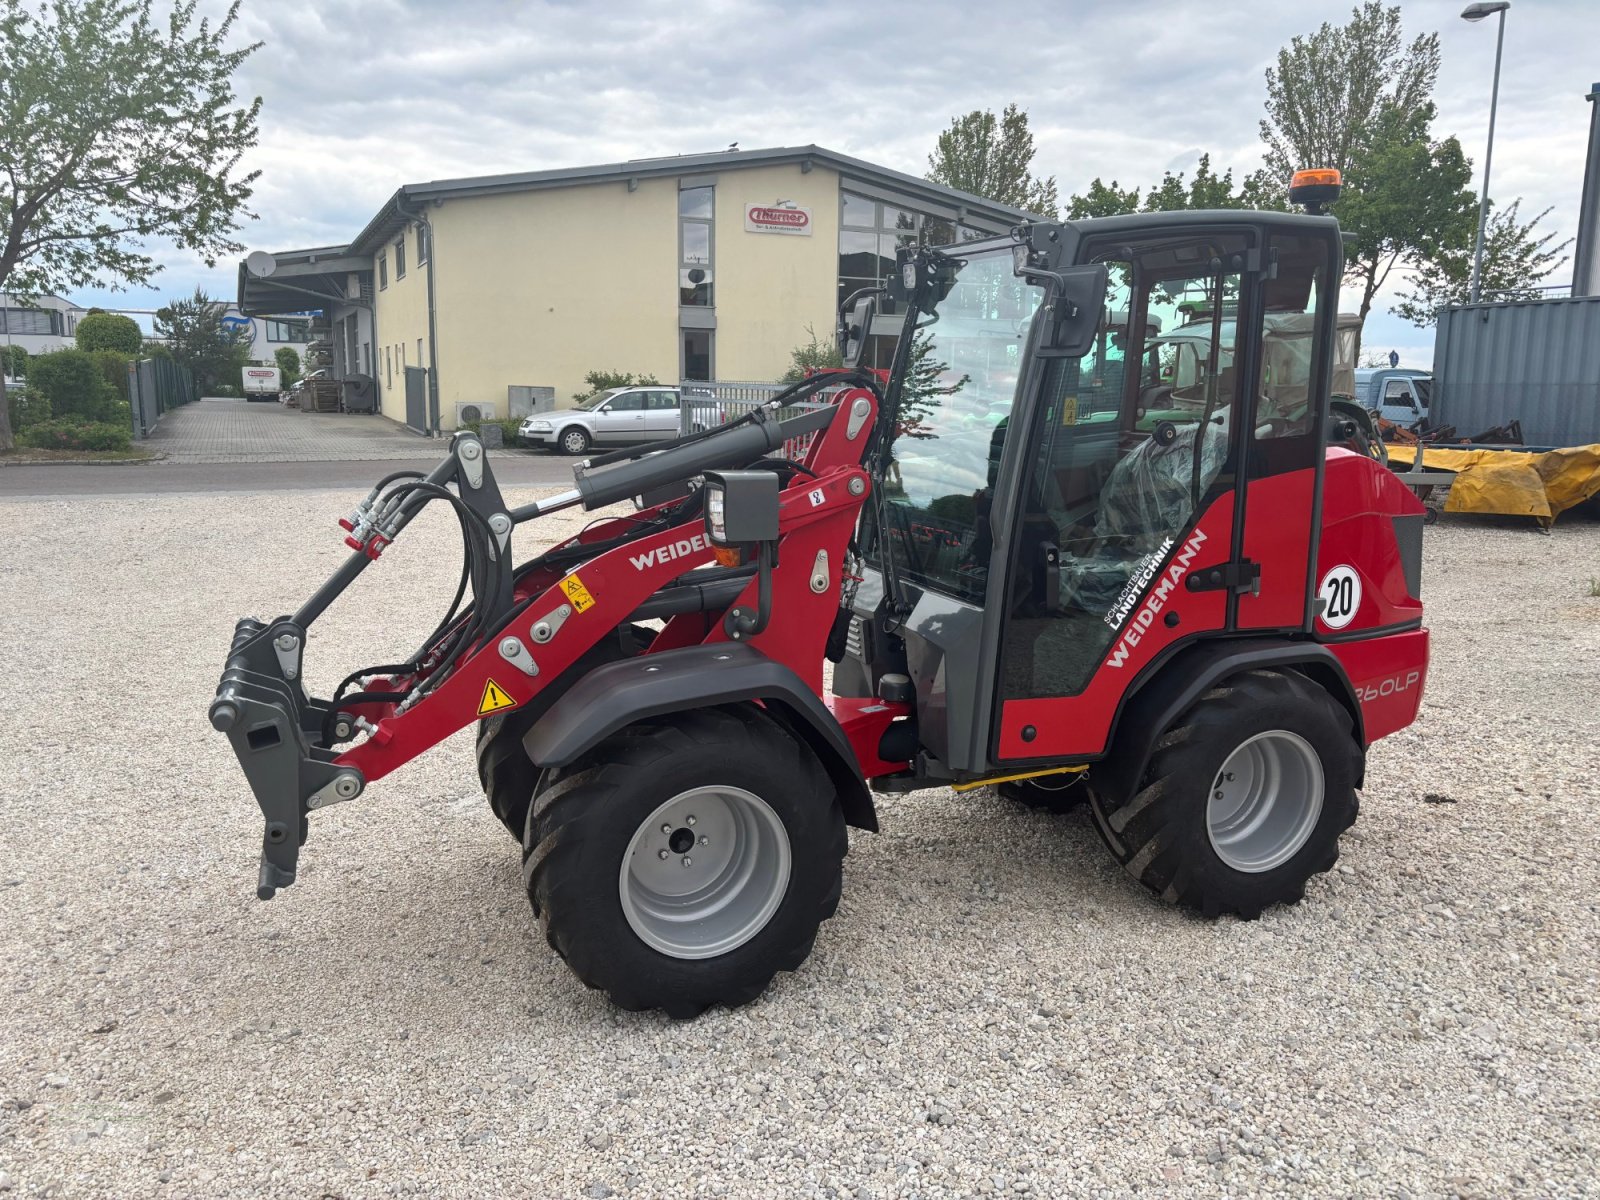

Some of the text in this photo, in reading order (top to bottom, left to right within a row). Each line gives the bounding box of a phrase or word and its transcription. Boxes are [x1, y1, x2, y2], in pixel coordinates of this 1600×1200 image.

[1104, 553, 1153, 624] SCHLACHTBAUER
[1106, 528, 1208, 668] WEIDEMANN
[1109, 535, 1175, 631] LANDTECHNIK
[1327, 576, 1353, 618] 20
